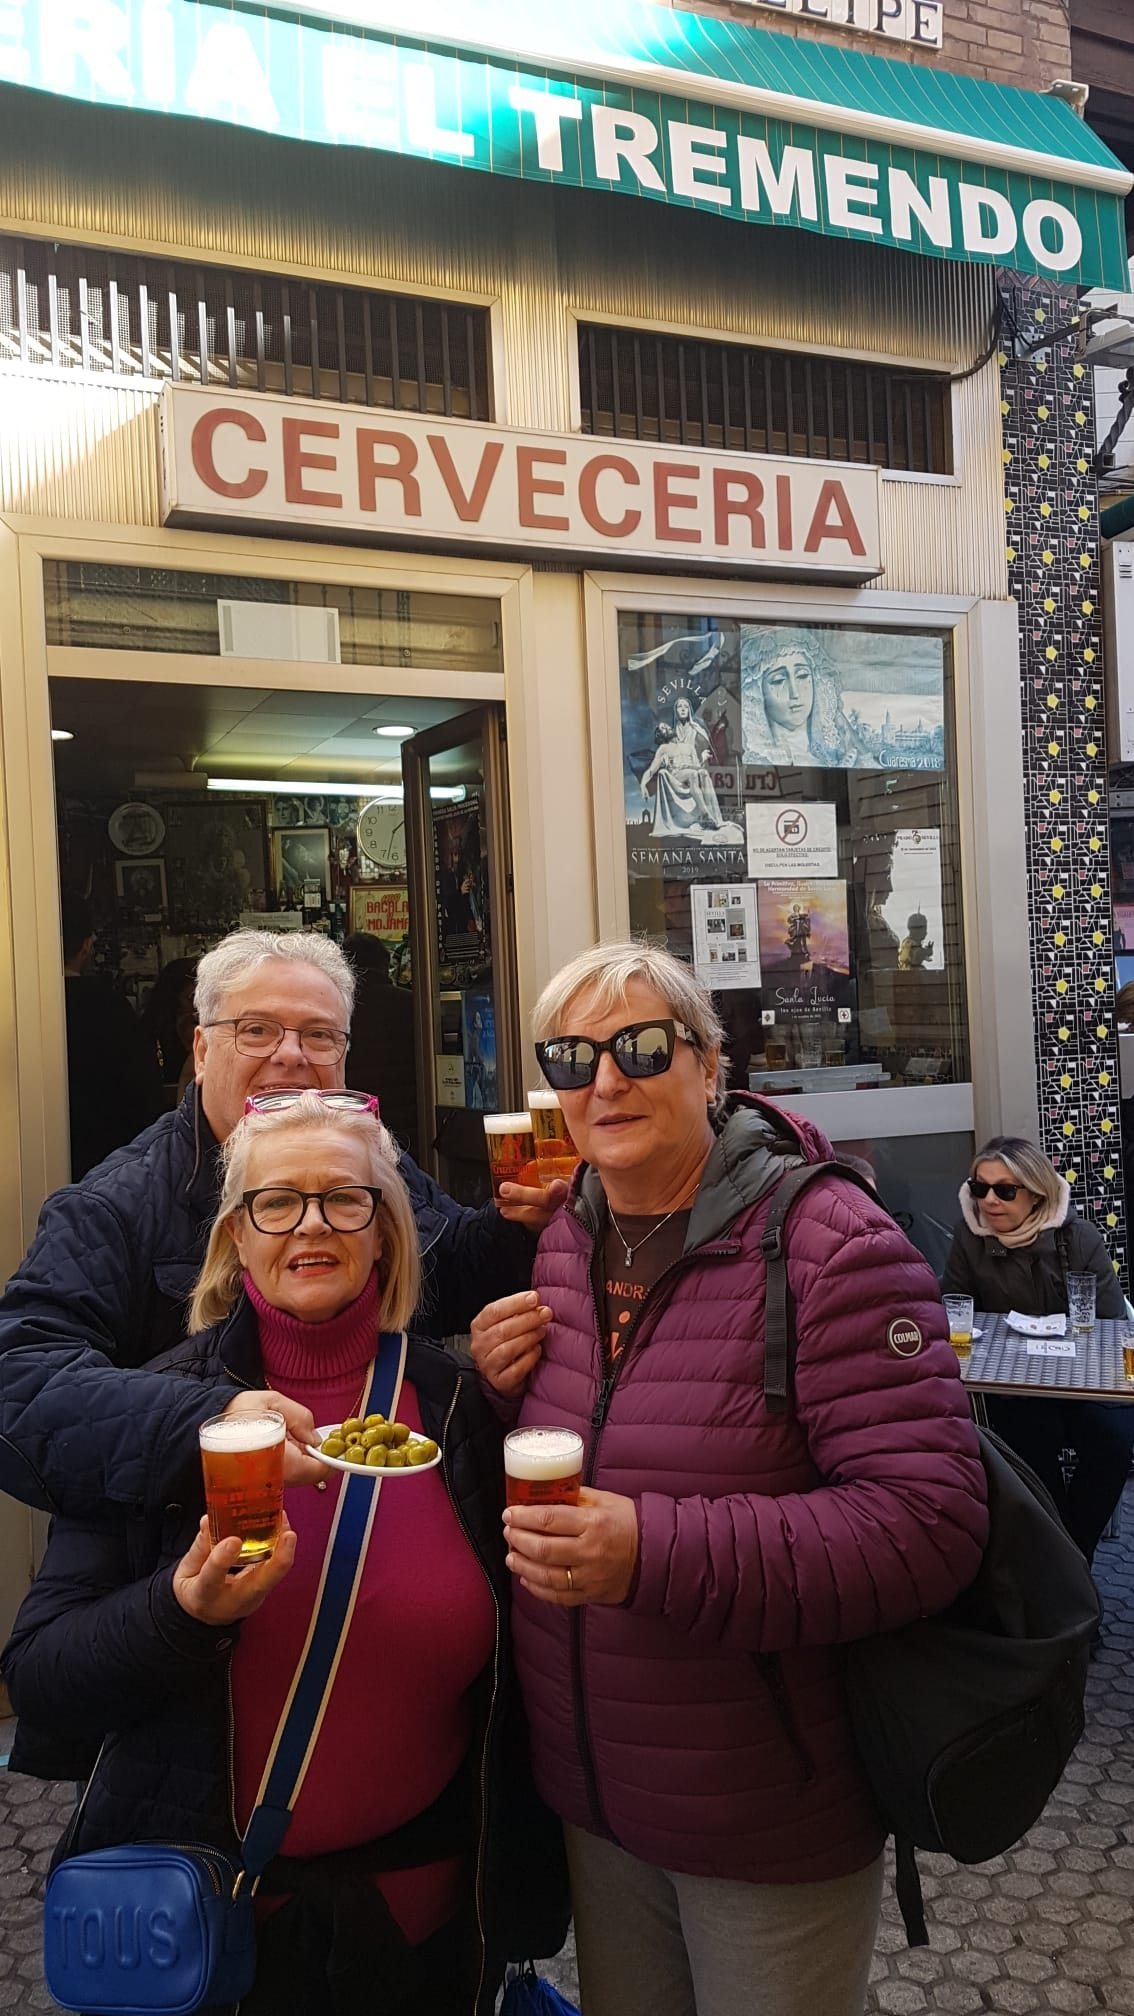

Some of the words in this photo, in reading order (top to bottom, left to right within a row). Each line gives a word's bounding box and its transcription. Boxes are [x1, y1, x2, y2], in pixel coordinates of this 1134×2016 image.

[757, 0, 938, 44] IPE
[322, 42, 475, 157] EL
[508, 85, 1083, 272] TREMENDO
[190, 407, 867, 557] CERVECERIA
[657, 678, 707, 704] SEVILLA
[917, 756, 941, 768] 2018
[367, 816, 378, 825] 10
[365, 828, 373, 837] 9
[370, 840, 378, 849] 8
[380, 849, 387, 859] 7
[391, 851, 399, 860] 6
[631, 850, 693, 865] SEMANA
[699, 850, 745, 865] SANTA
[775, 987, 804, 1006] Santa
[53, 1904, 181, 1969] TOUS
